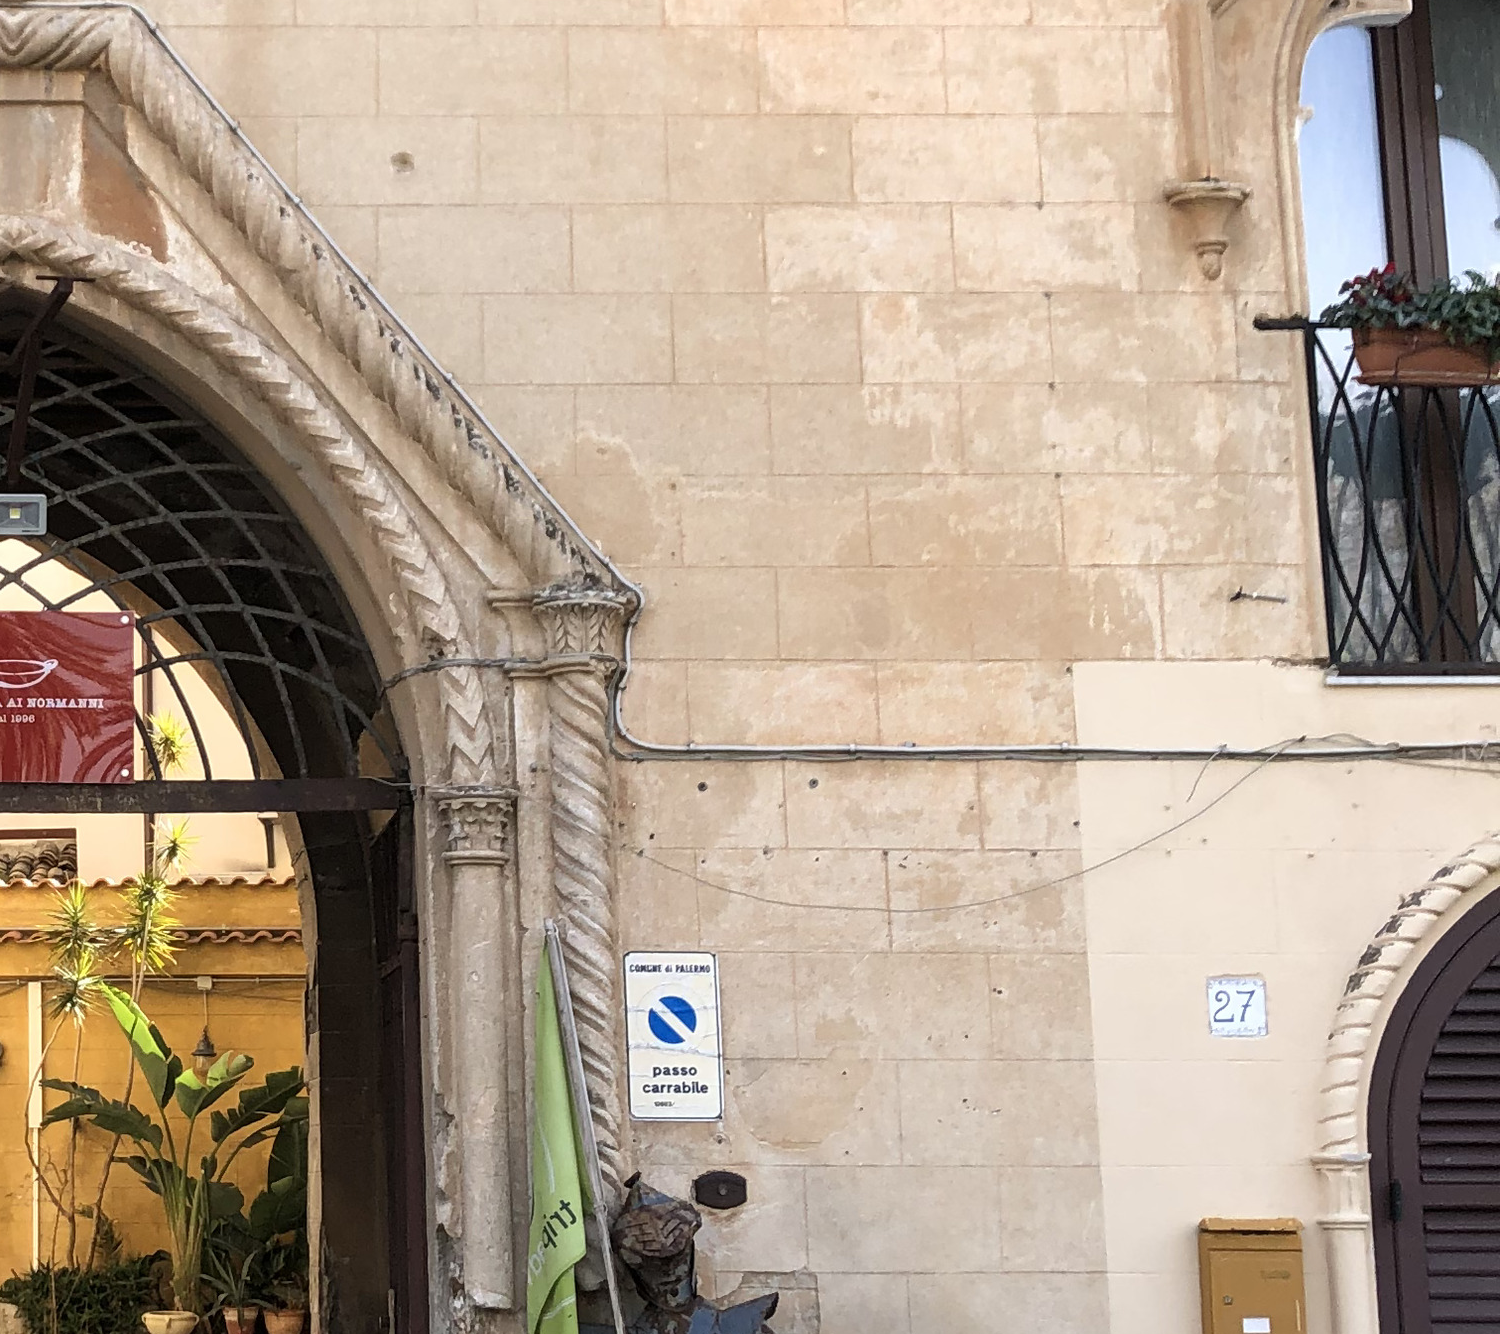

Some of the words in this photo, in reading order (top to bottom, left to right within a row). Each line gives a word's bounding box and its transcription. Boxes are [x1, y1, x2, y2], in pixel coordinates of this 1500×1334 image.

[6, 697, 23, 708] AI
[27, 697, 104, 709] NORMANNI
[11, 714, 35, 723] 1996
[629, 964, 662, 973] COMUNE
[665, 964, 673, 973] di
[675, 964, 711, 973] PALERMO
[1213, 989, 1256, 1023] 27
[652, 1066, 698, 1078] passo
[642, 1081, 709, 1094] carrabile
